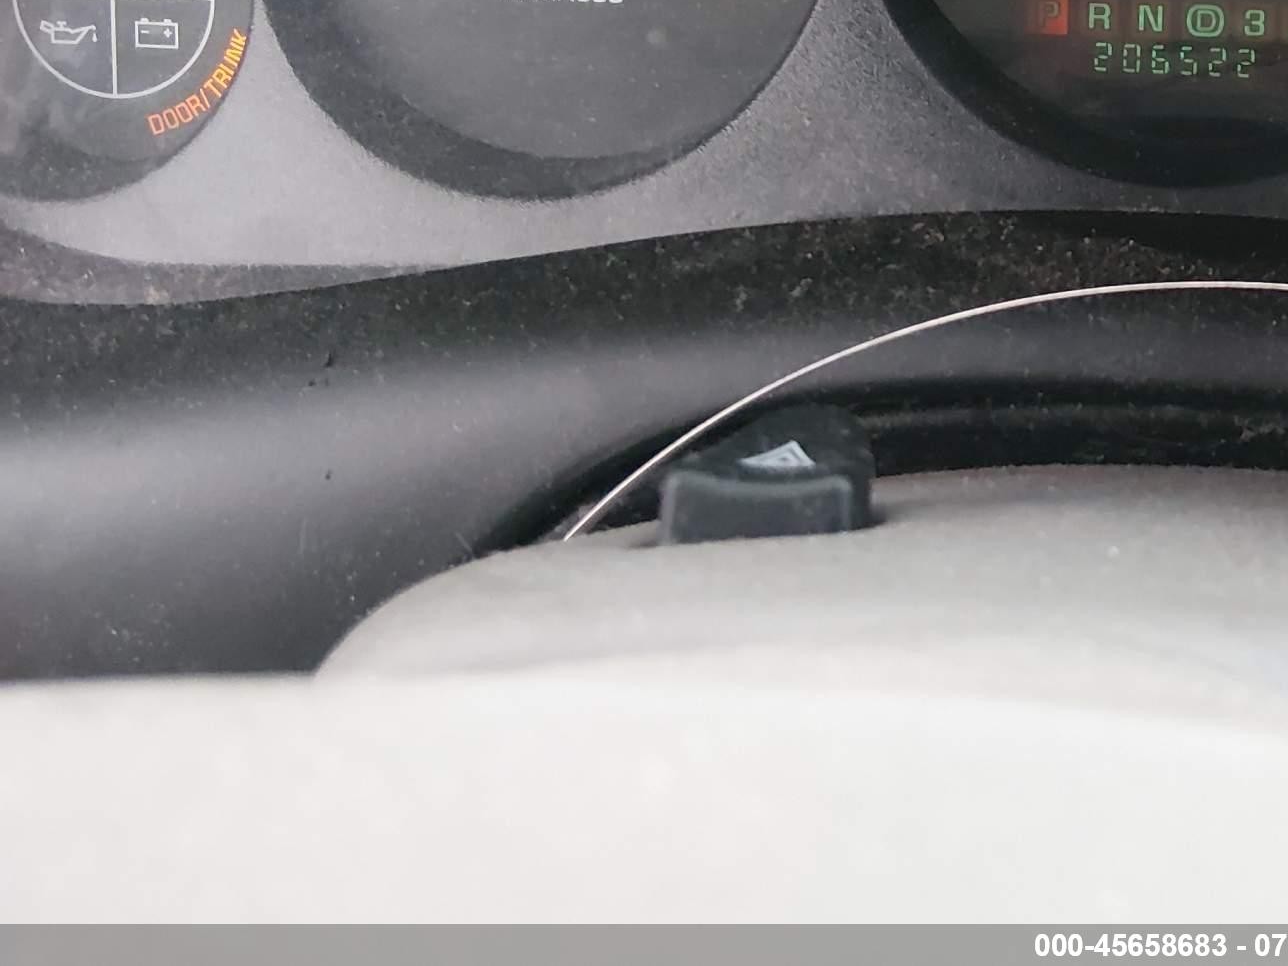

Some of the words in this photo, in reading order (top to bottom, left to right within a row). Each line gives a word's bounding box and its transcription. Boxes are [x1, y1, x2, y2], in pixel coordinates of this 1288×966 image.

[1038, 0, 1059, 27] P
[1088, 2, 1112, 30] R
[1138, 4, 1164, 32] N
[1244, 9, 1265, 36] 3
[1094, 42, 1256, 78] 206522
[148, 28, 247, 135] DOOR/TRUNK
